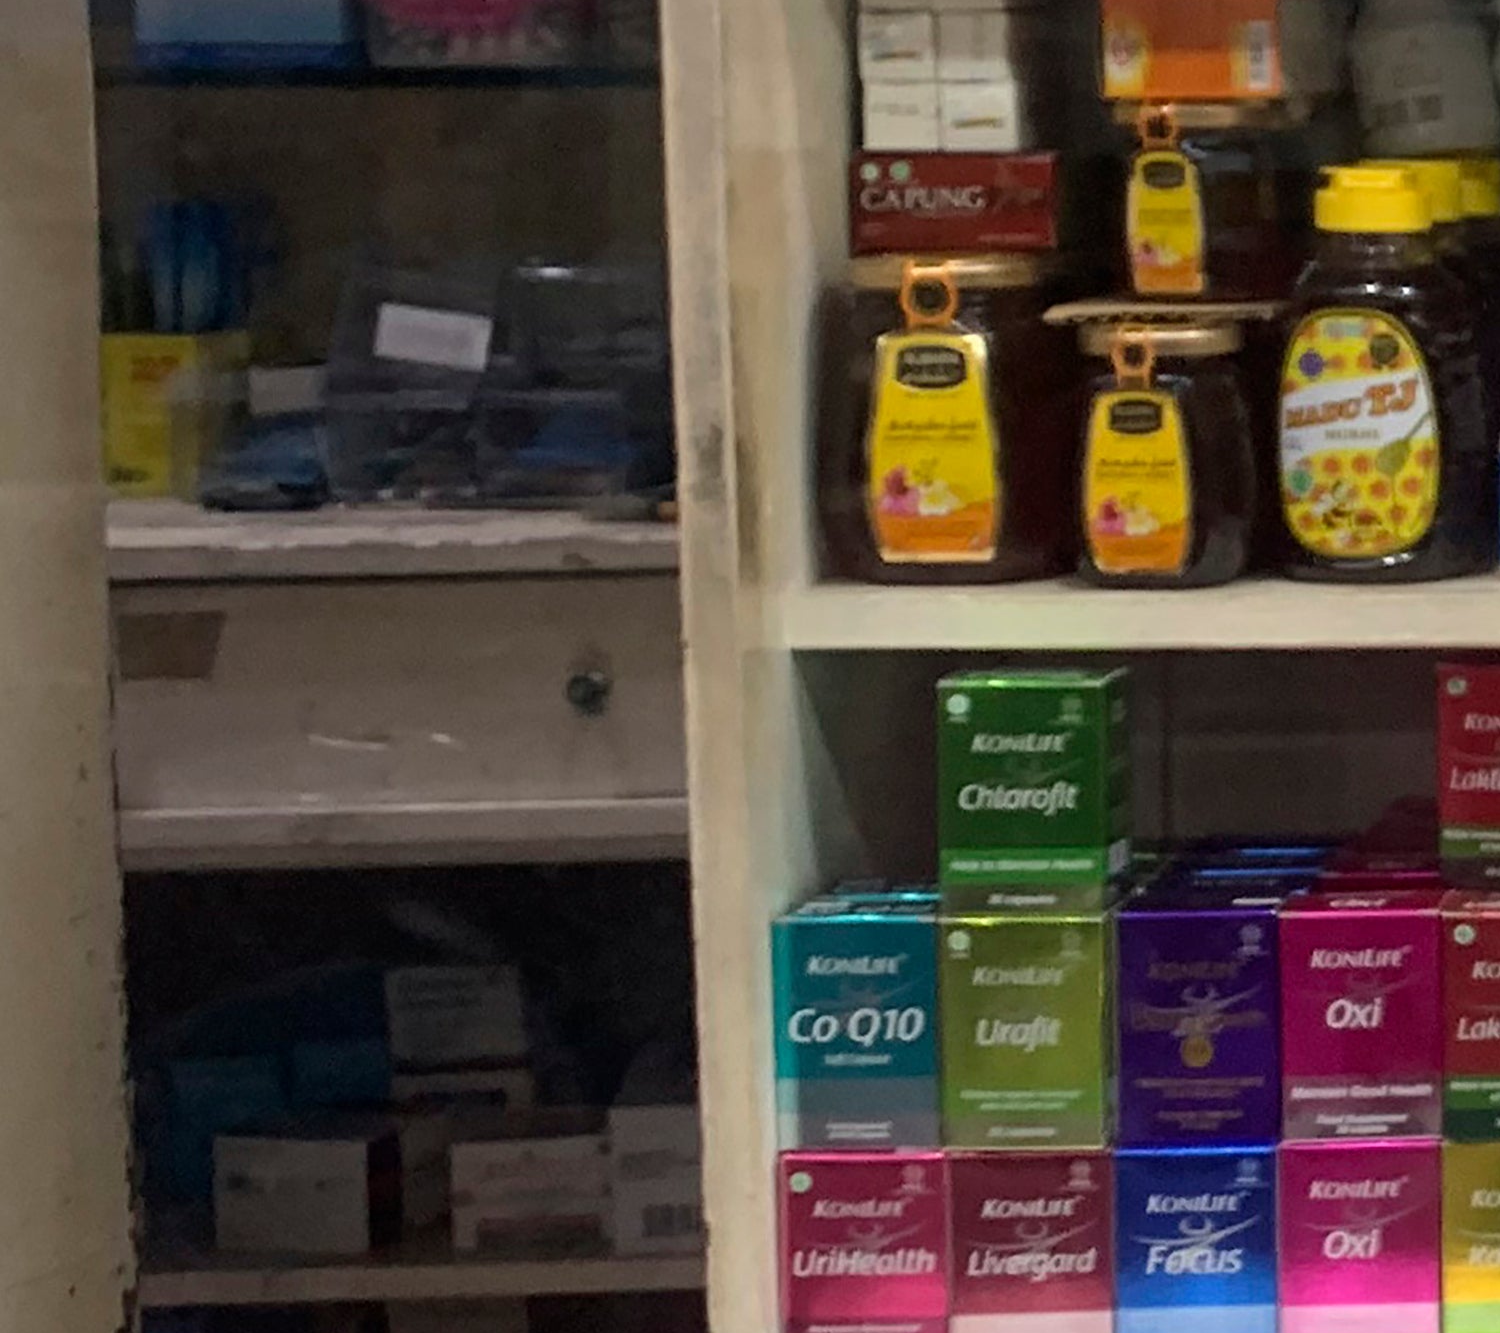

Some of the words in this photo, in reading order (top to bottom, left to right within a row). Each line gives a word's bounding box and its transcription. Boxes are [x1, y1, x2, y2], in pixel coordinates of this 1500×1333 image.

[861, 186, 986, 211] CAPUNG
[1364, 379, 1418, 416] TJ
[788, 1011, 841, 1044] Co
[848, 1007, 924, 1047] Q10
[1326, 998, 1384, 1029] Oxi
[1146, 1244, 1243, 1275] Focus
[1322, 1228, 1379, 1260] Oxi
